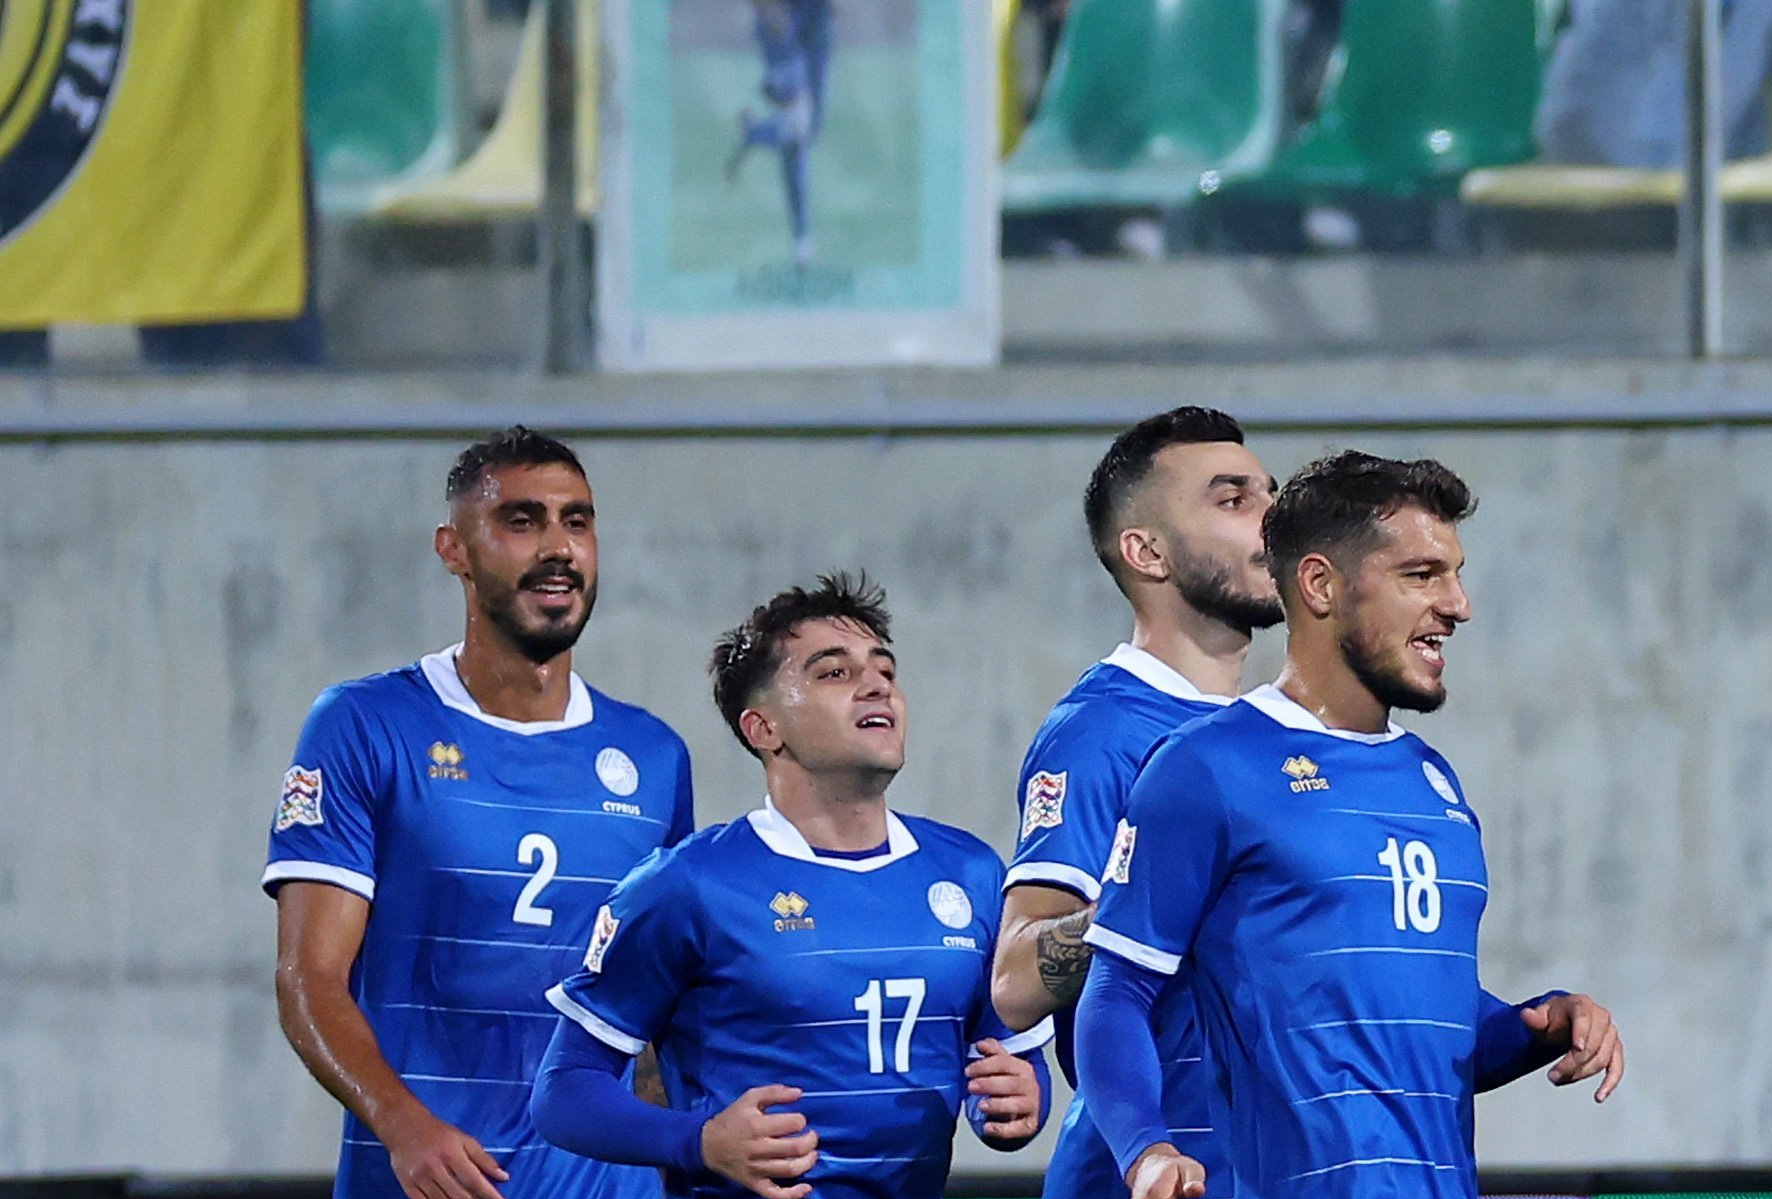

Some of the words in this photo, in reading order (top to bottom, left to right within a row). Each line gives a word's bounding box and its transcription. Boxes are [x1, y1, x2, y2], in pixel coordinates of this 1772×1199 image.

[602, 800, 641, 816] CYPRUS
[513, 833, 558, 926] 2
[1377, 837, 1441, 934] 18
[854, 978, 926, 1074] 17
